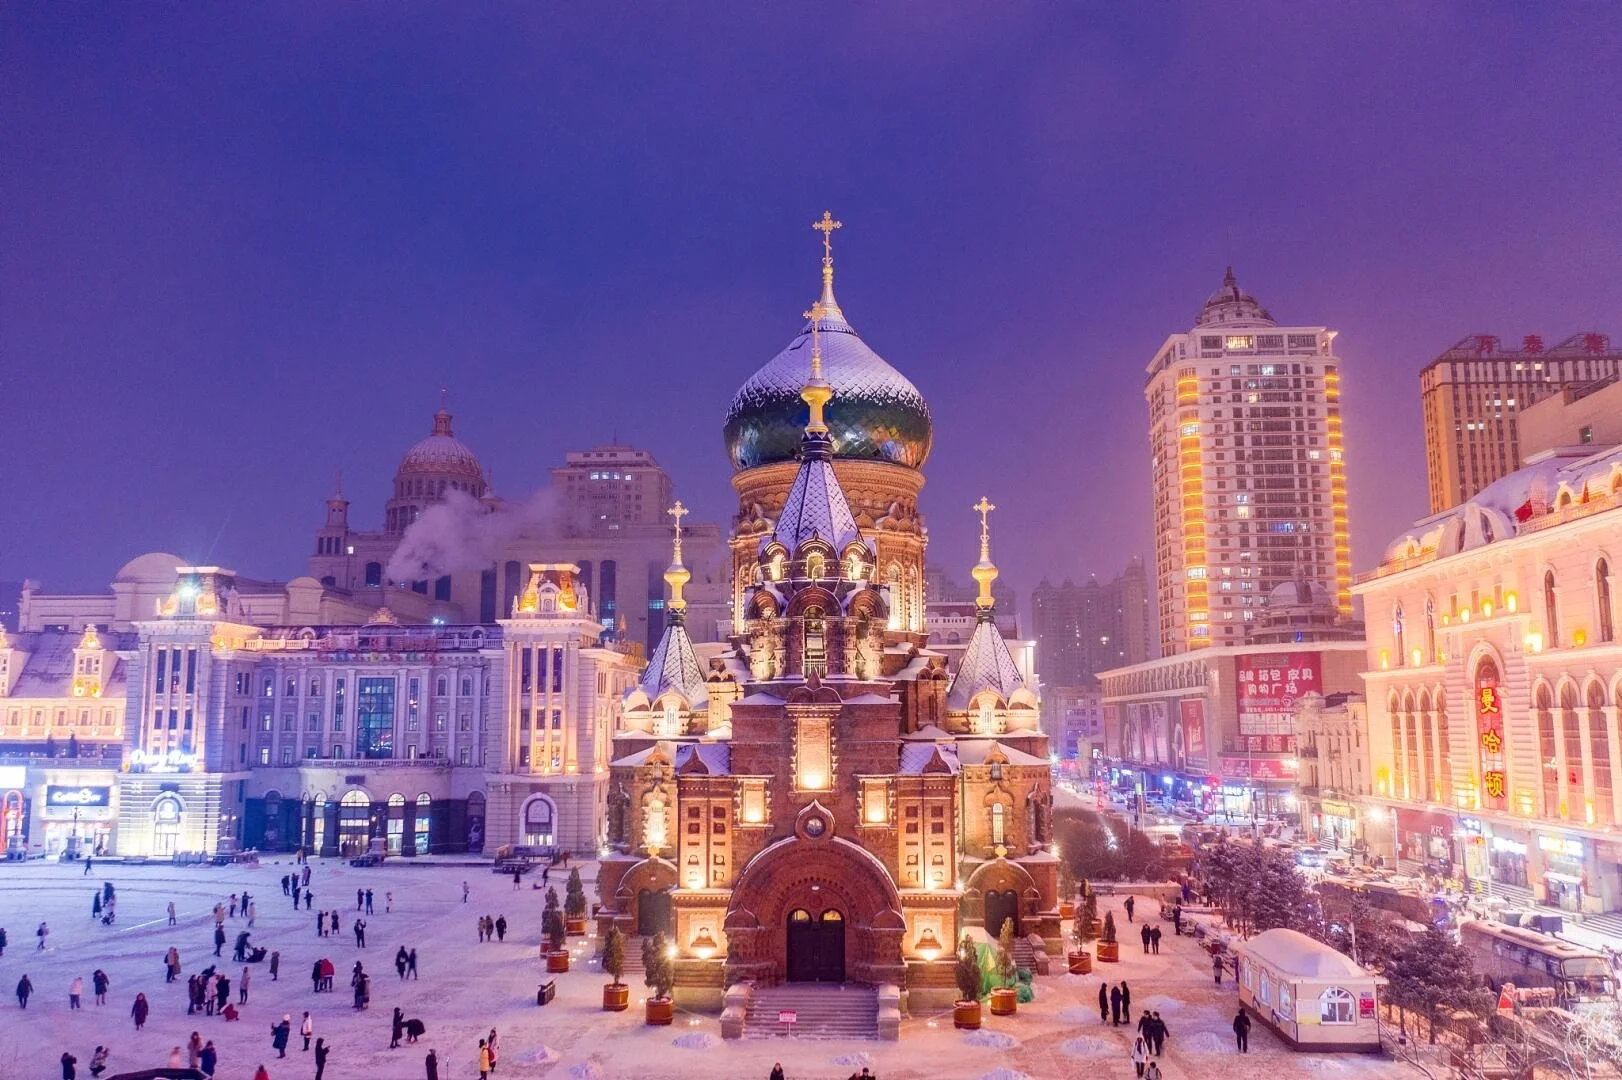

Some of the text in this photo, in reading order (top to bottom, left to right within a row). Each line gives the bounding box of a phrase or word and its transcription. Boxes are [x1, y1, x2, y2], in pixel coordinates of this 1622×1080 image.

[1258, 669, 1281, 681] 箱包
[1287, 668, 1313, 681] 皮具
[1248, 682, 1297, 695] 购物广场
[1480, 687, 1505, 798] 曼哈顿
[1431, 825, 1444, 836] KFC
